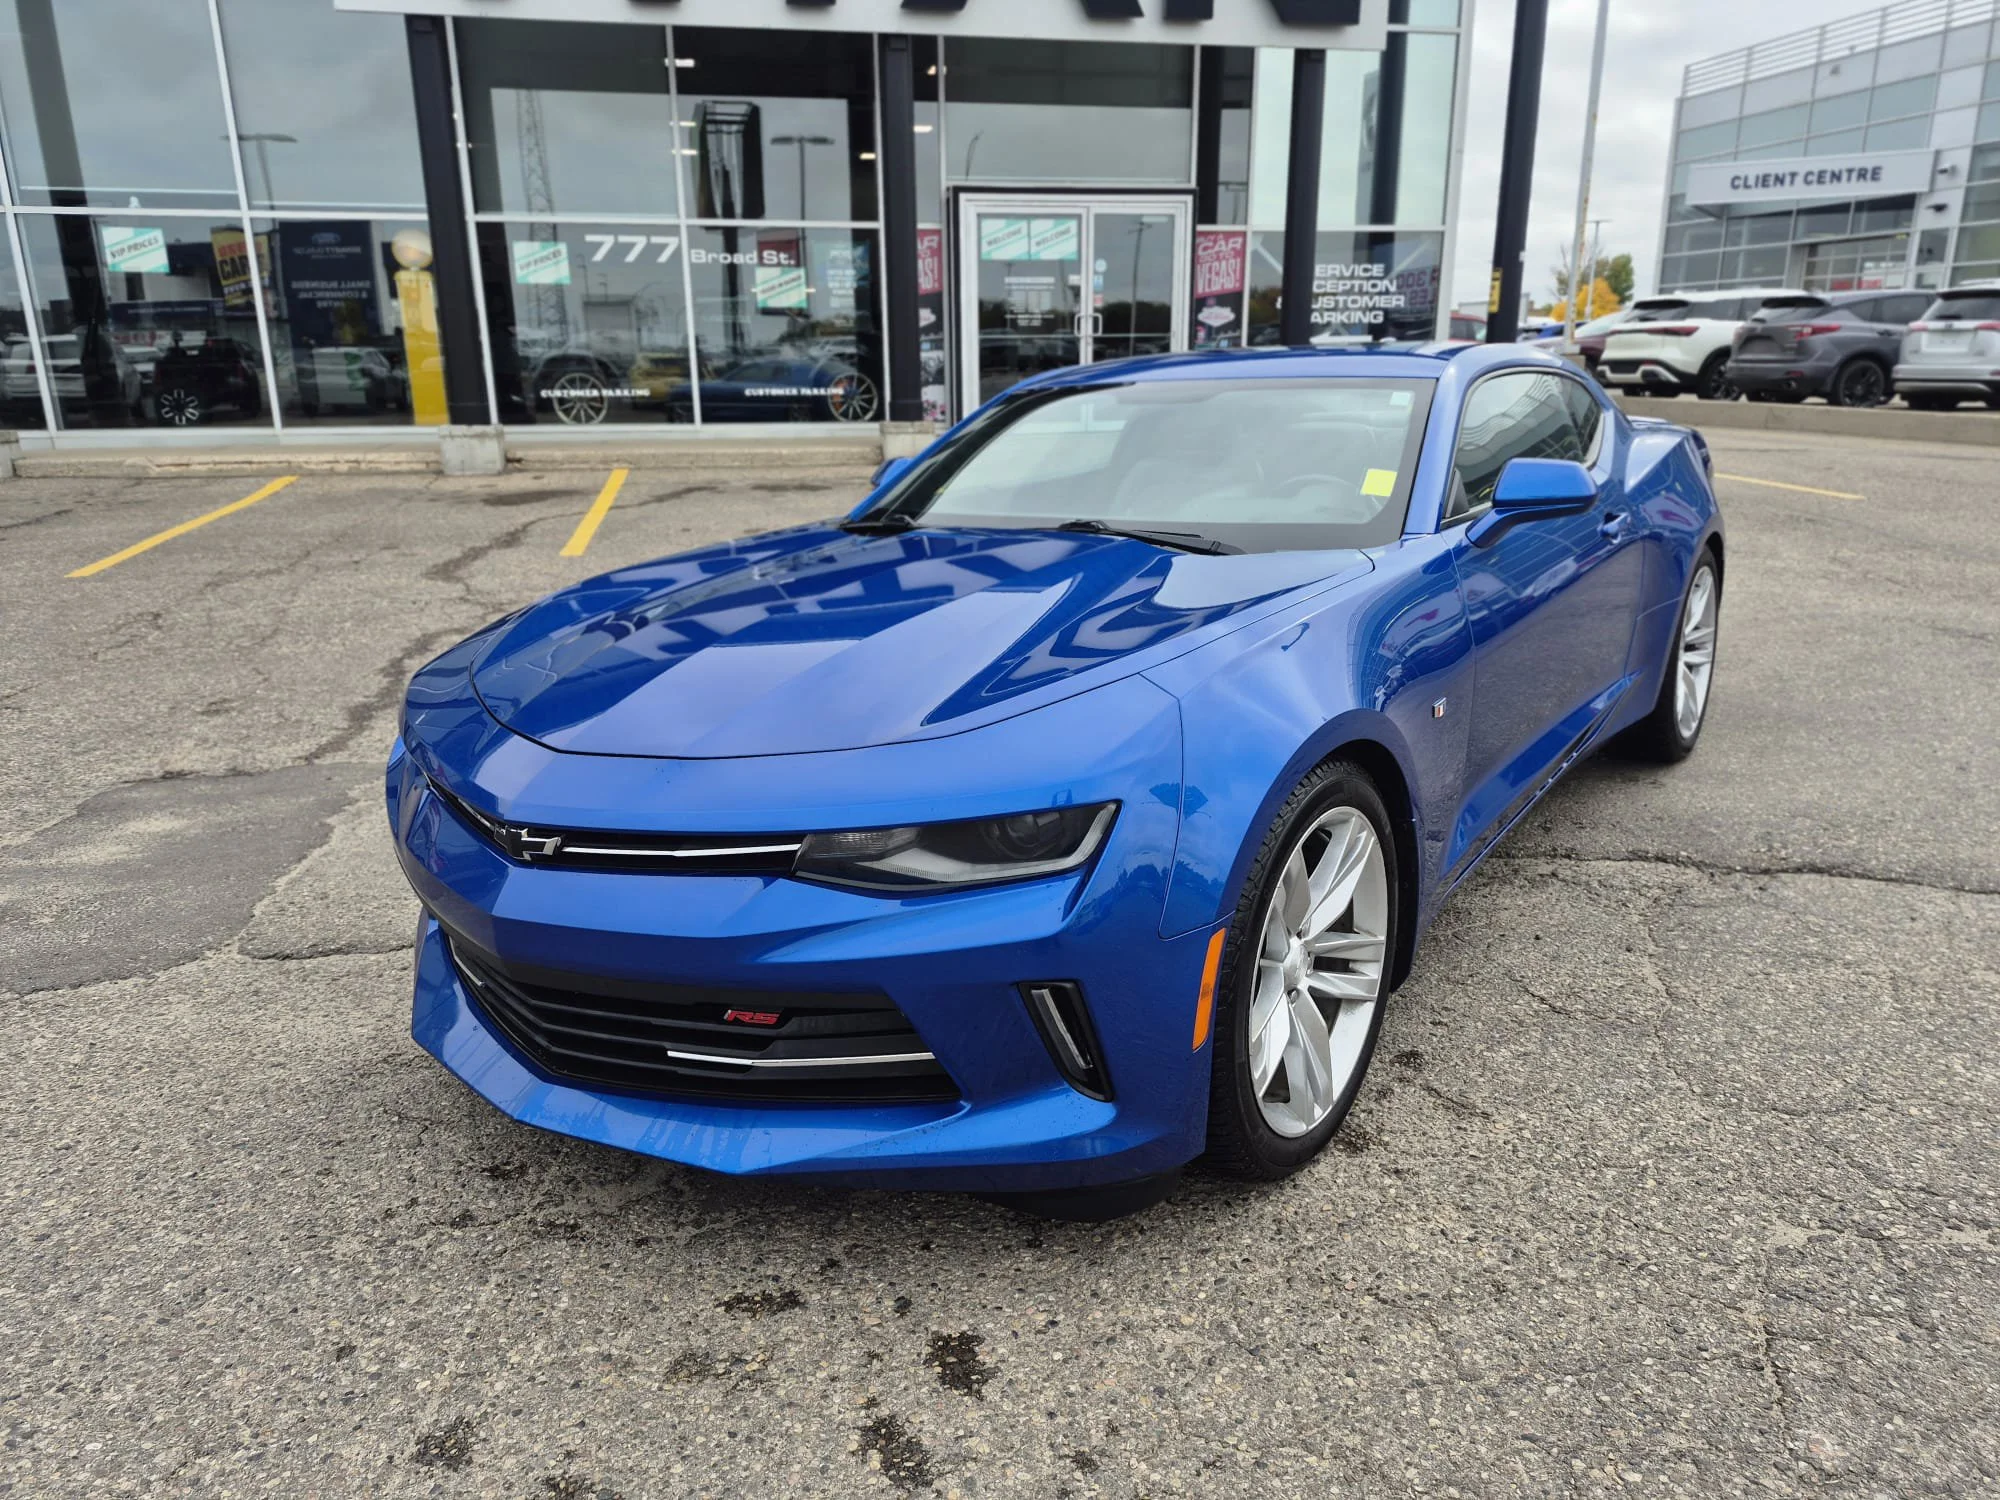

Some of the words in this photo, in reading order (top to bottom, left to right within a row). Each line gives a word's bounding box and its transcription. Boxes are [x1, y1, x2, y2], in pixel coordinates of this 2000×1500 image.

[1730, 171, 1799, 190] CLIENT
[1803, 165, 1883, 186] CENTRE
[126, 235, 160, 254] PRICES
[584, 234, 679, 263] 777
[690, 249, 758, 264] Broad
[762, 249, 796, 265] St.
[917, 234, 940, 250] AR
[1198, 237, 1243, 256] CAR
[1197, 257, 1241, 294] VEGAS!
[1315, 263, 1386, 278] ERVICE
[1312, 279, 1398, 294] CEPTION
[1311, 295, 1406, 310] USTOMER
[1310, 310, 1385, 325] ARKING
[540, 388, 599, 398] CUSTOMER
[601, 388, 651, 397] PARKING
[744, 387, 798, 397] CUSTOMER
[799, 387, 844, 396] PARKING
[723, 1009, 780, 1025] RS
